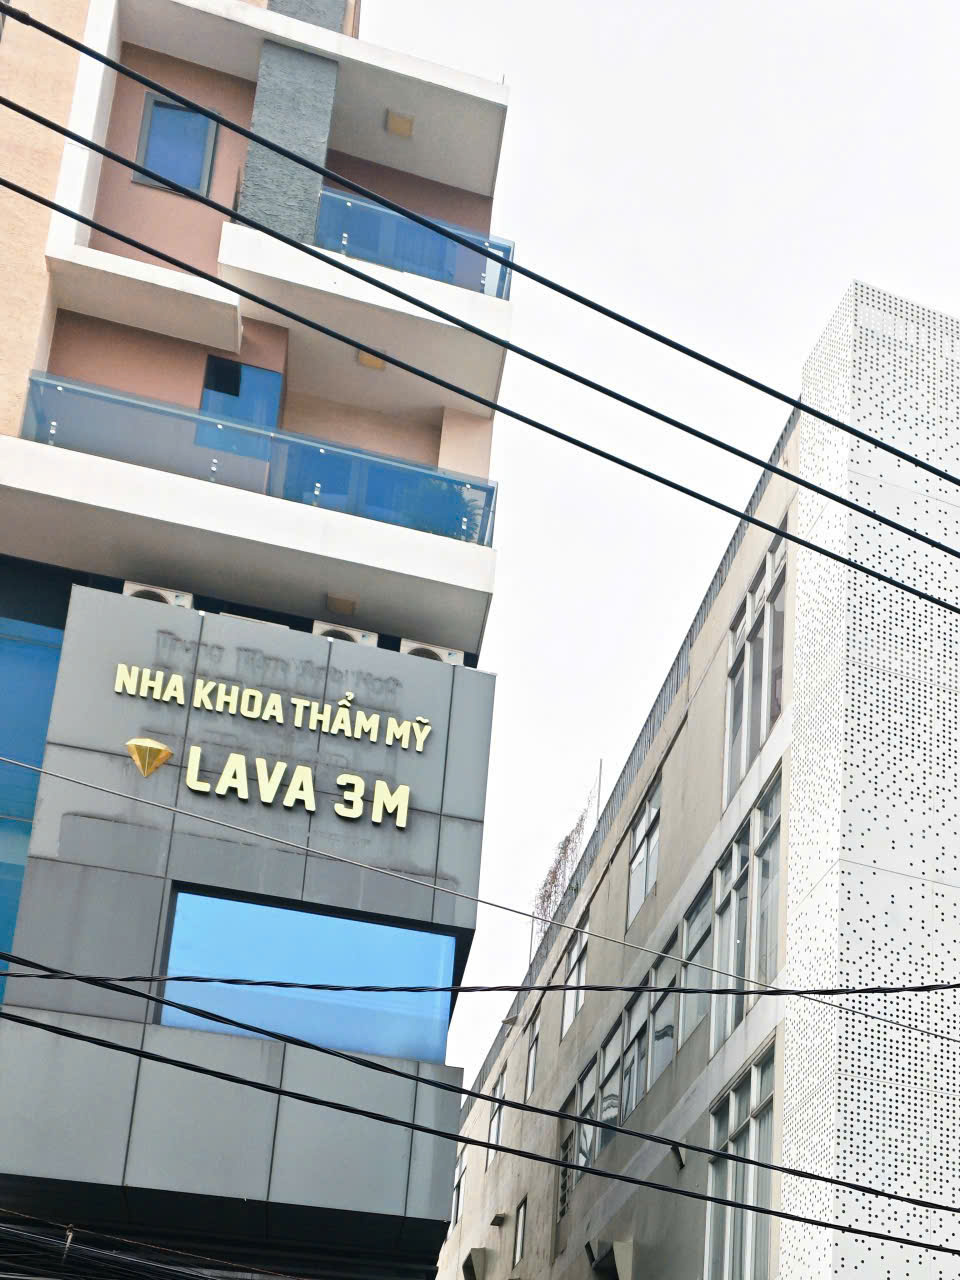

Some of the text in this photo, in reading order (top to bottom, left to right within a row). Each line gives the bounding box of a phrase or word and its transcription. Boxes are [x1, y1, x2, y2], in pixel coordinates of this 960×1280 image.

[114, 663, 432, 752] NHA KHOA THẨM MỸ
[185, 746, 411, 828] LAVA 3M
